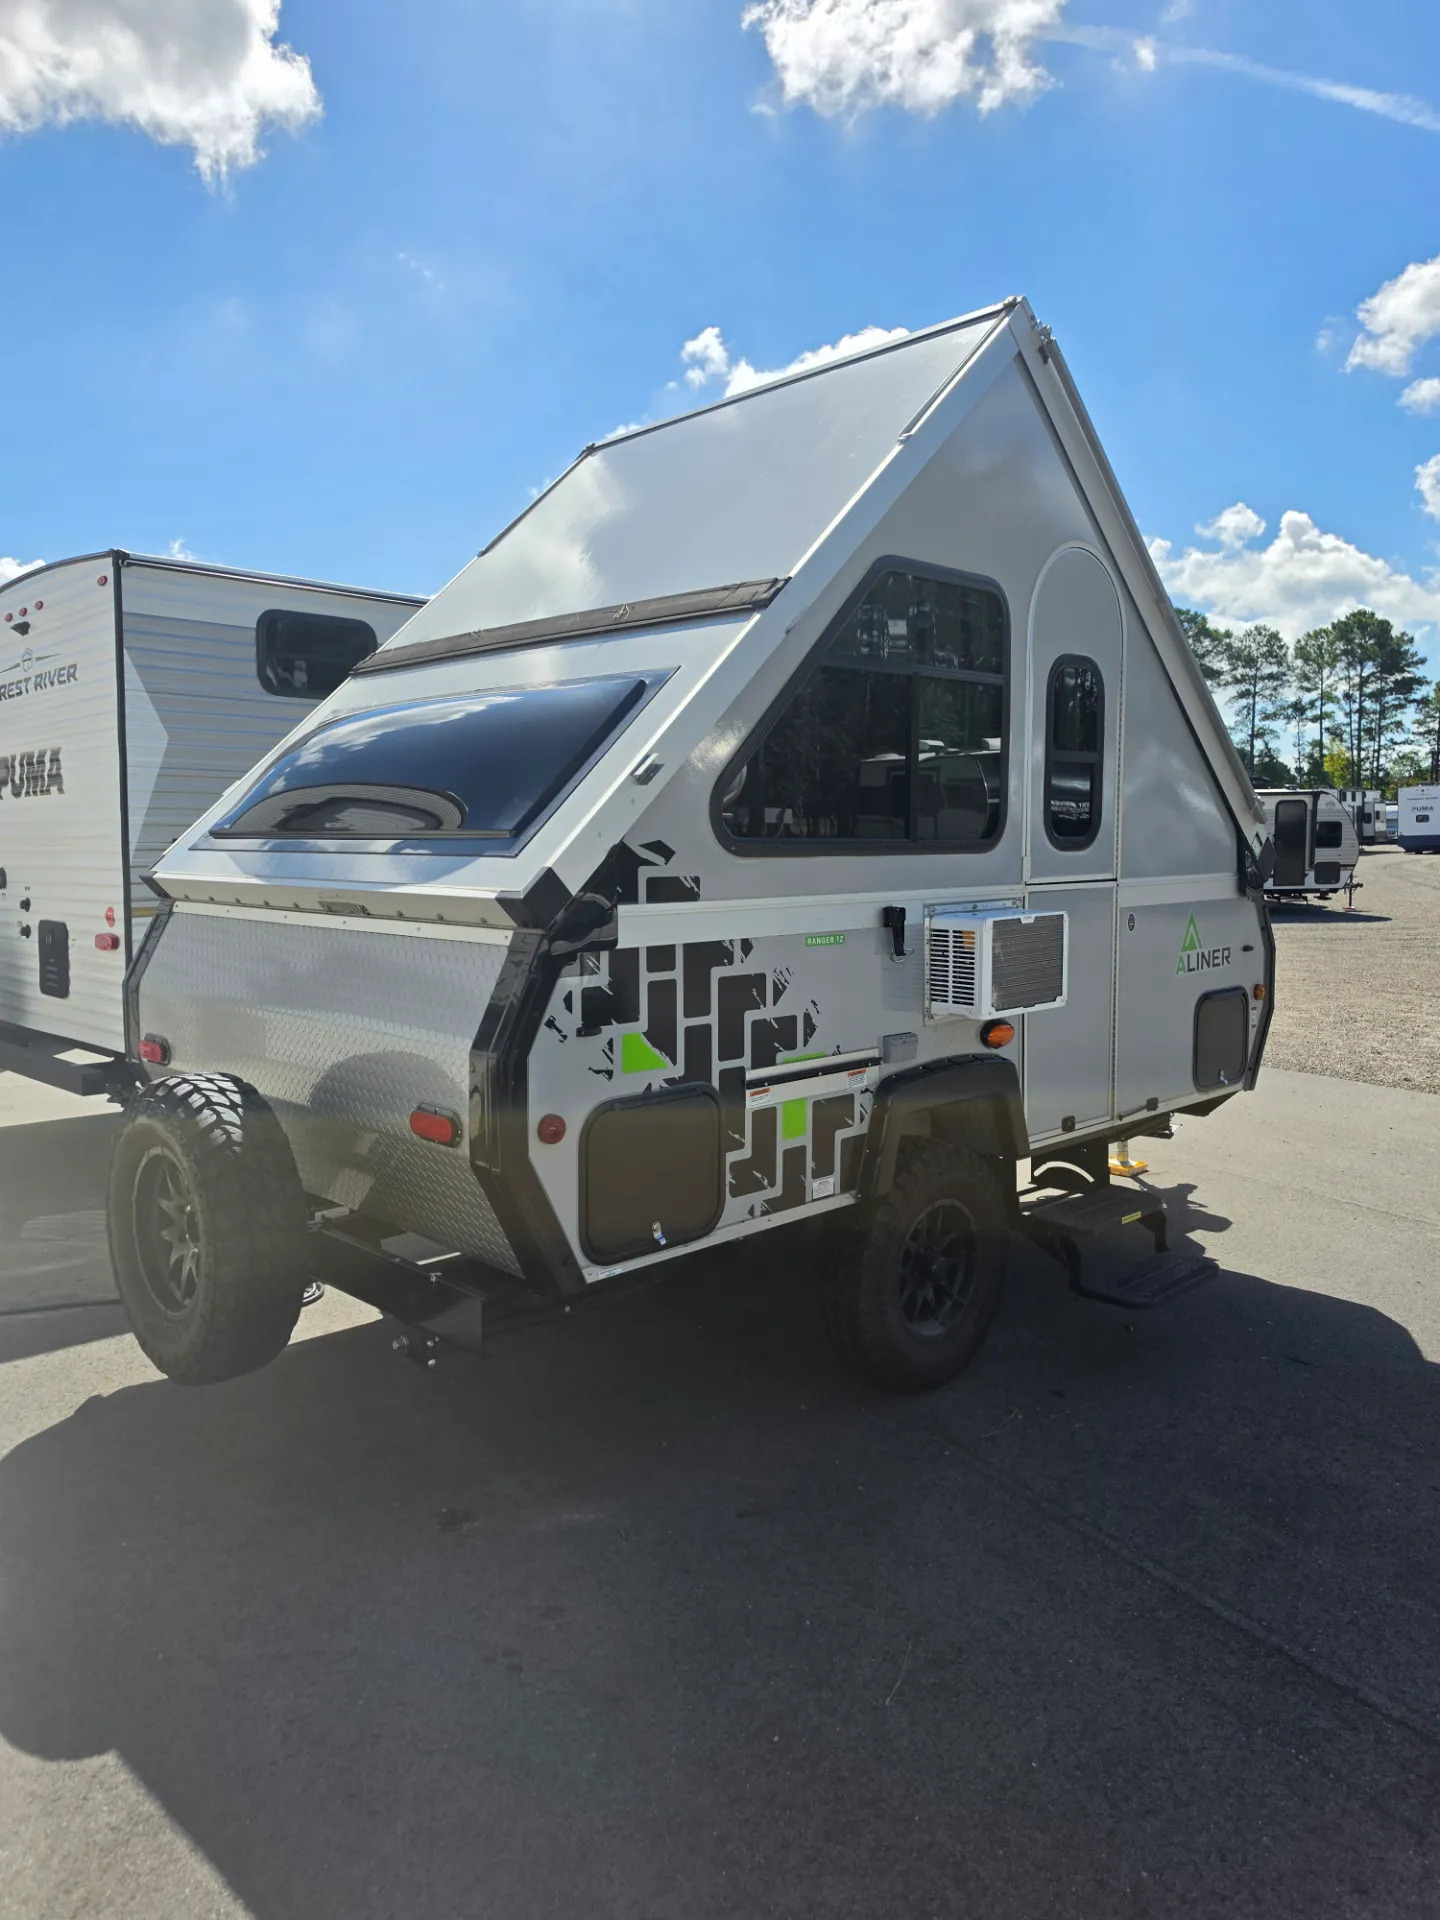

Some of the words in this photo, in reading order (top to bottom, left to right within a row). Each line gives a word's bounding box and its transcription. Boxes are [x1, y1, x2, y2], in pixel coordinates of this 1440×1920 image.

[34, 663, 78, 691] RIVER
[807, 936, 834, 946] RANGER
[836, 935, 844, 943] 12
[1176, 947, 1231, 975] ALINER
